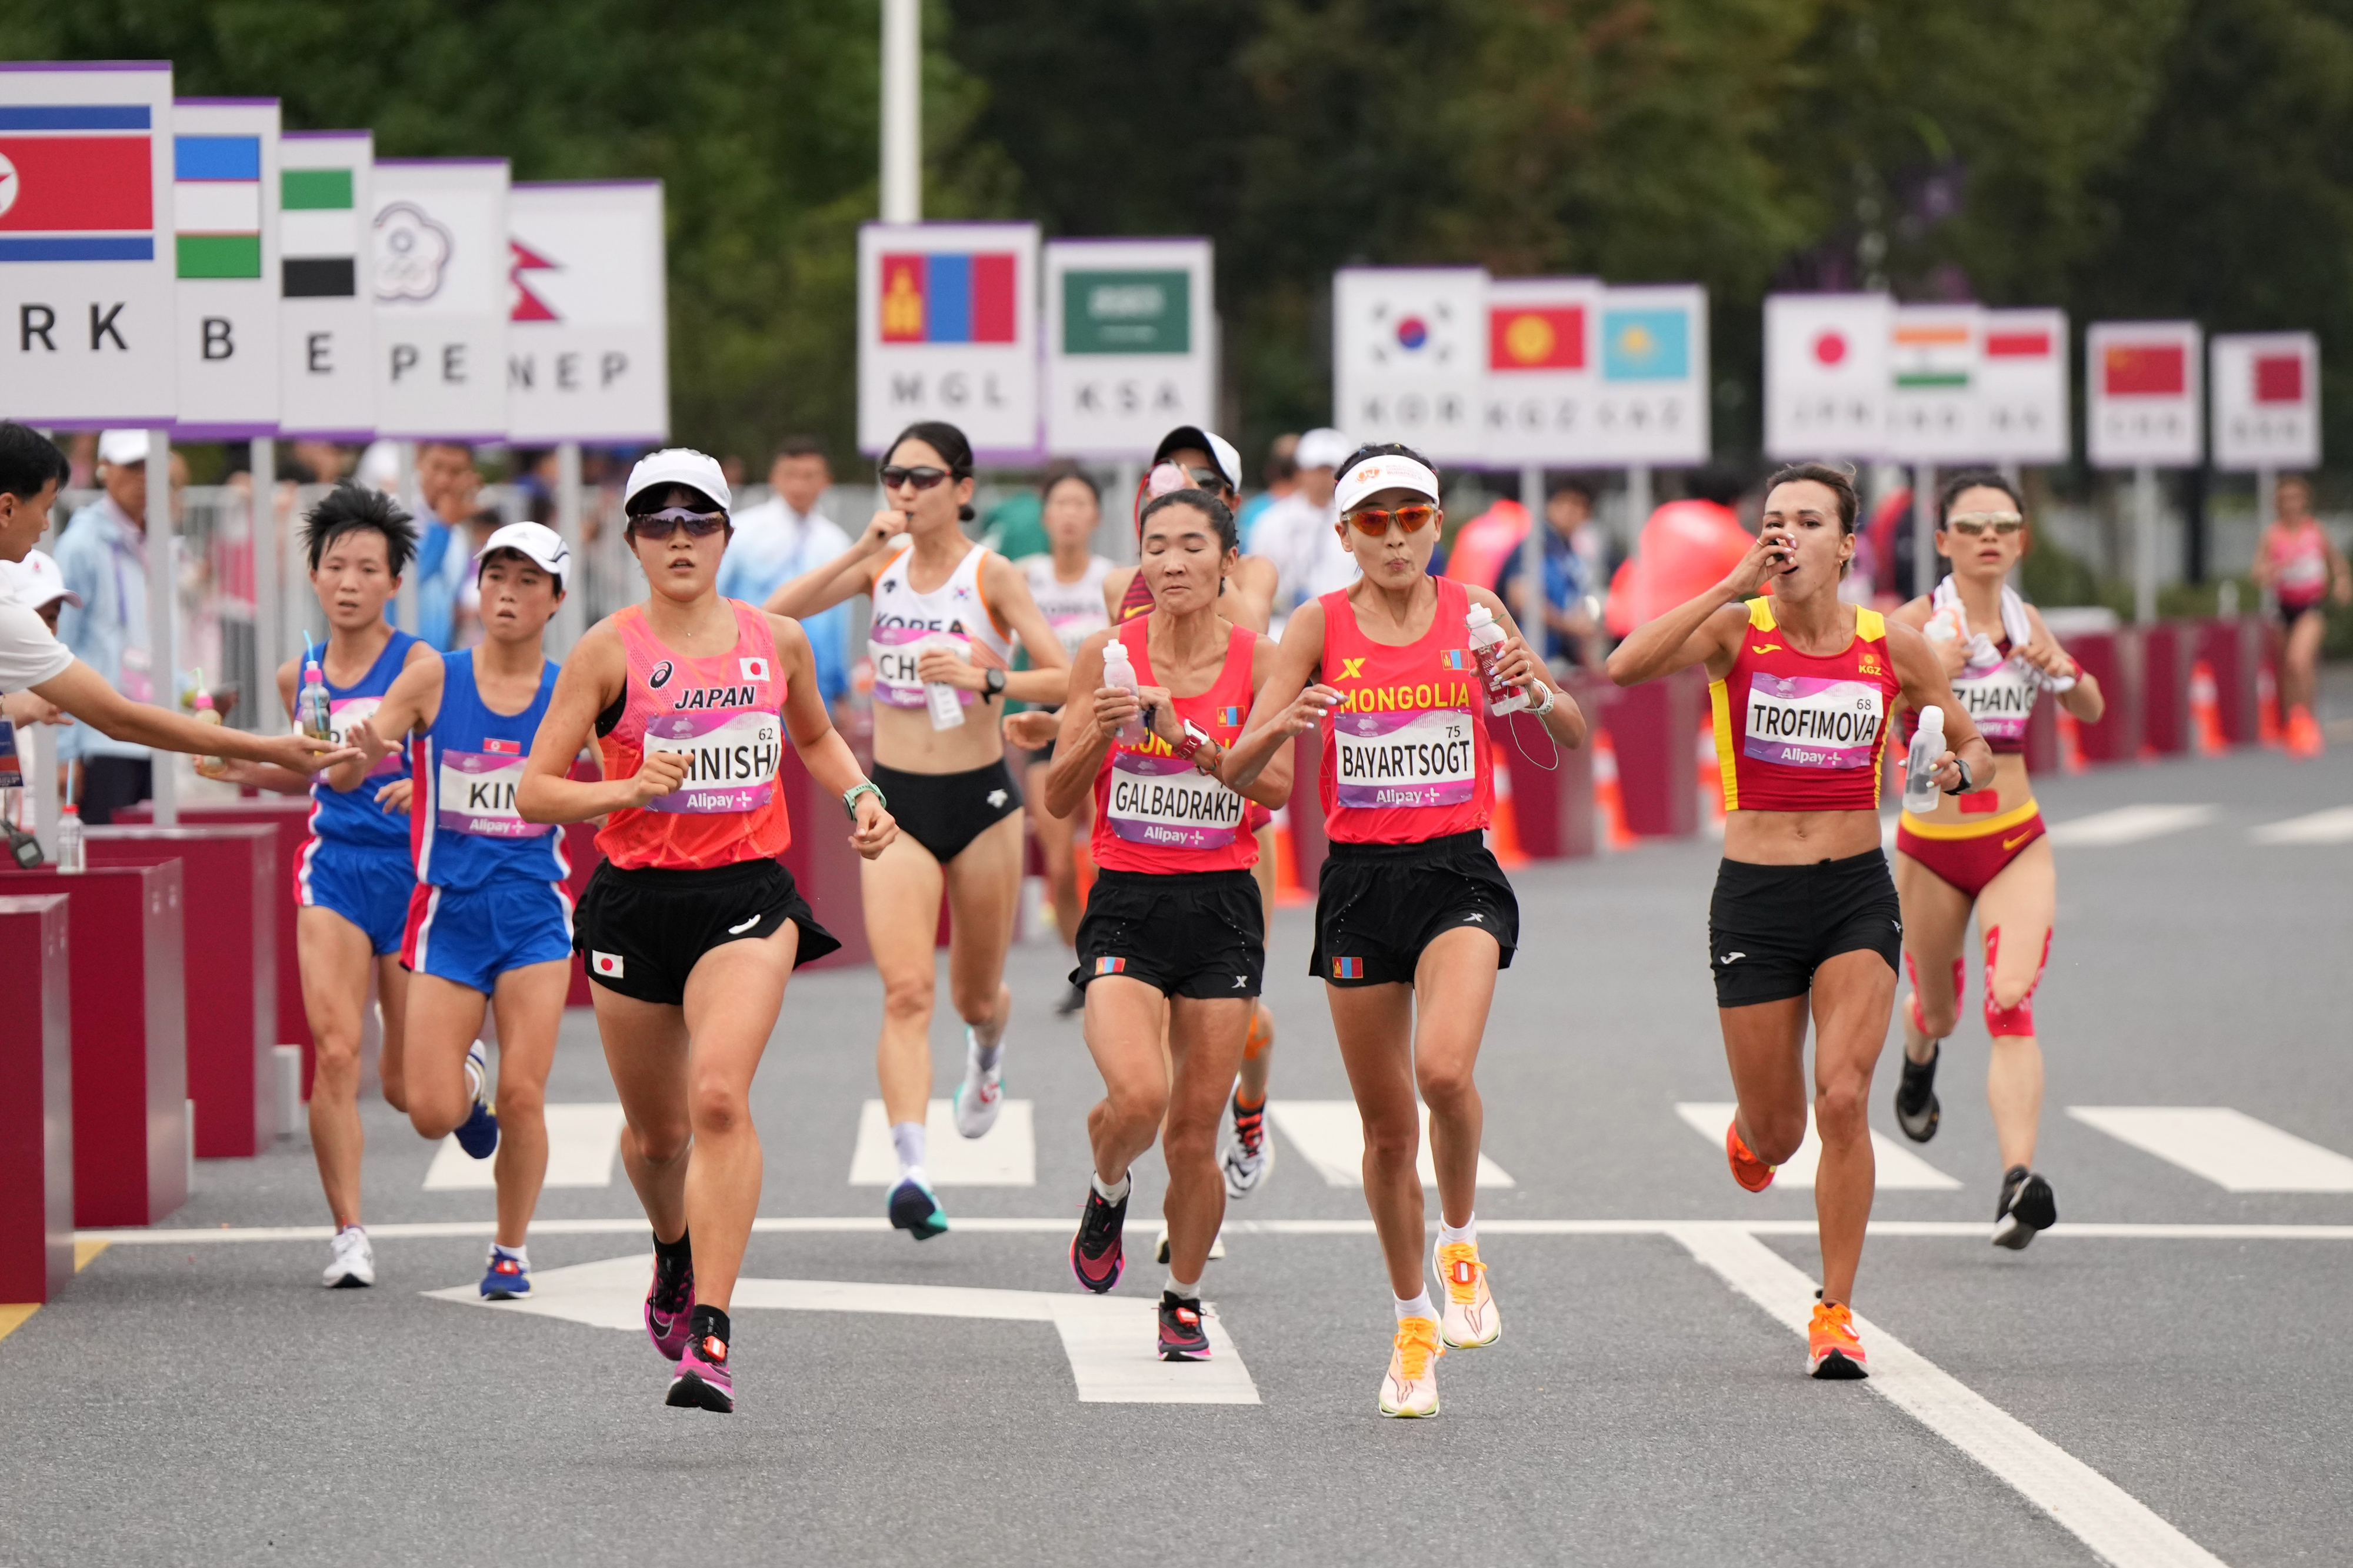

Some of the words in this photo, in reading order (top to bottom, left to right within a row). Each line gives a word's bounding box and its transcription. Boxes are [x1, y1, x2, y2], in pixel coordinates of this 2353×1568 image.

[20, 302, 129, 352] RK
[201, 316, 235, 361] B
[306, 331, 334, 374] E
[390, 343, 468, 383] PE
[881, 653, 915, 681] CH
[1858, 665, 1882, 675] KGZ
[675, 685, 756, 709] JAPAN
[1339, 682, 1469, 714] MONGOLIA
[1857, 698, 1872, 710] 68
[758, 728, 774, 740] 62
[1446, 726, 1461, 738] 75
[1753, 704, 1876, 741] TROFIMOVA
[656, 742, 779, 782] HNISHI
[1342, 740, 1470, 778] BAYARTSOGT
[1115, 781, 1241, 822] GALBADRAKH
